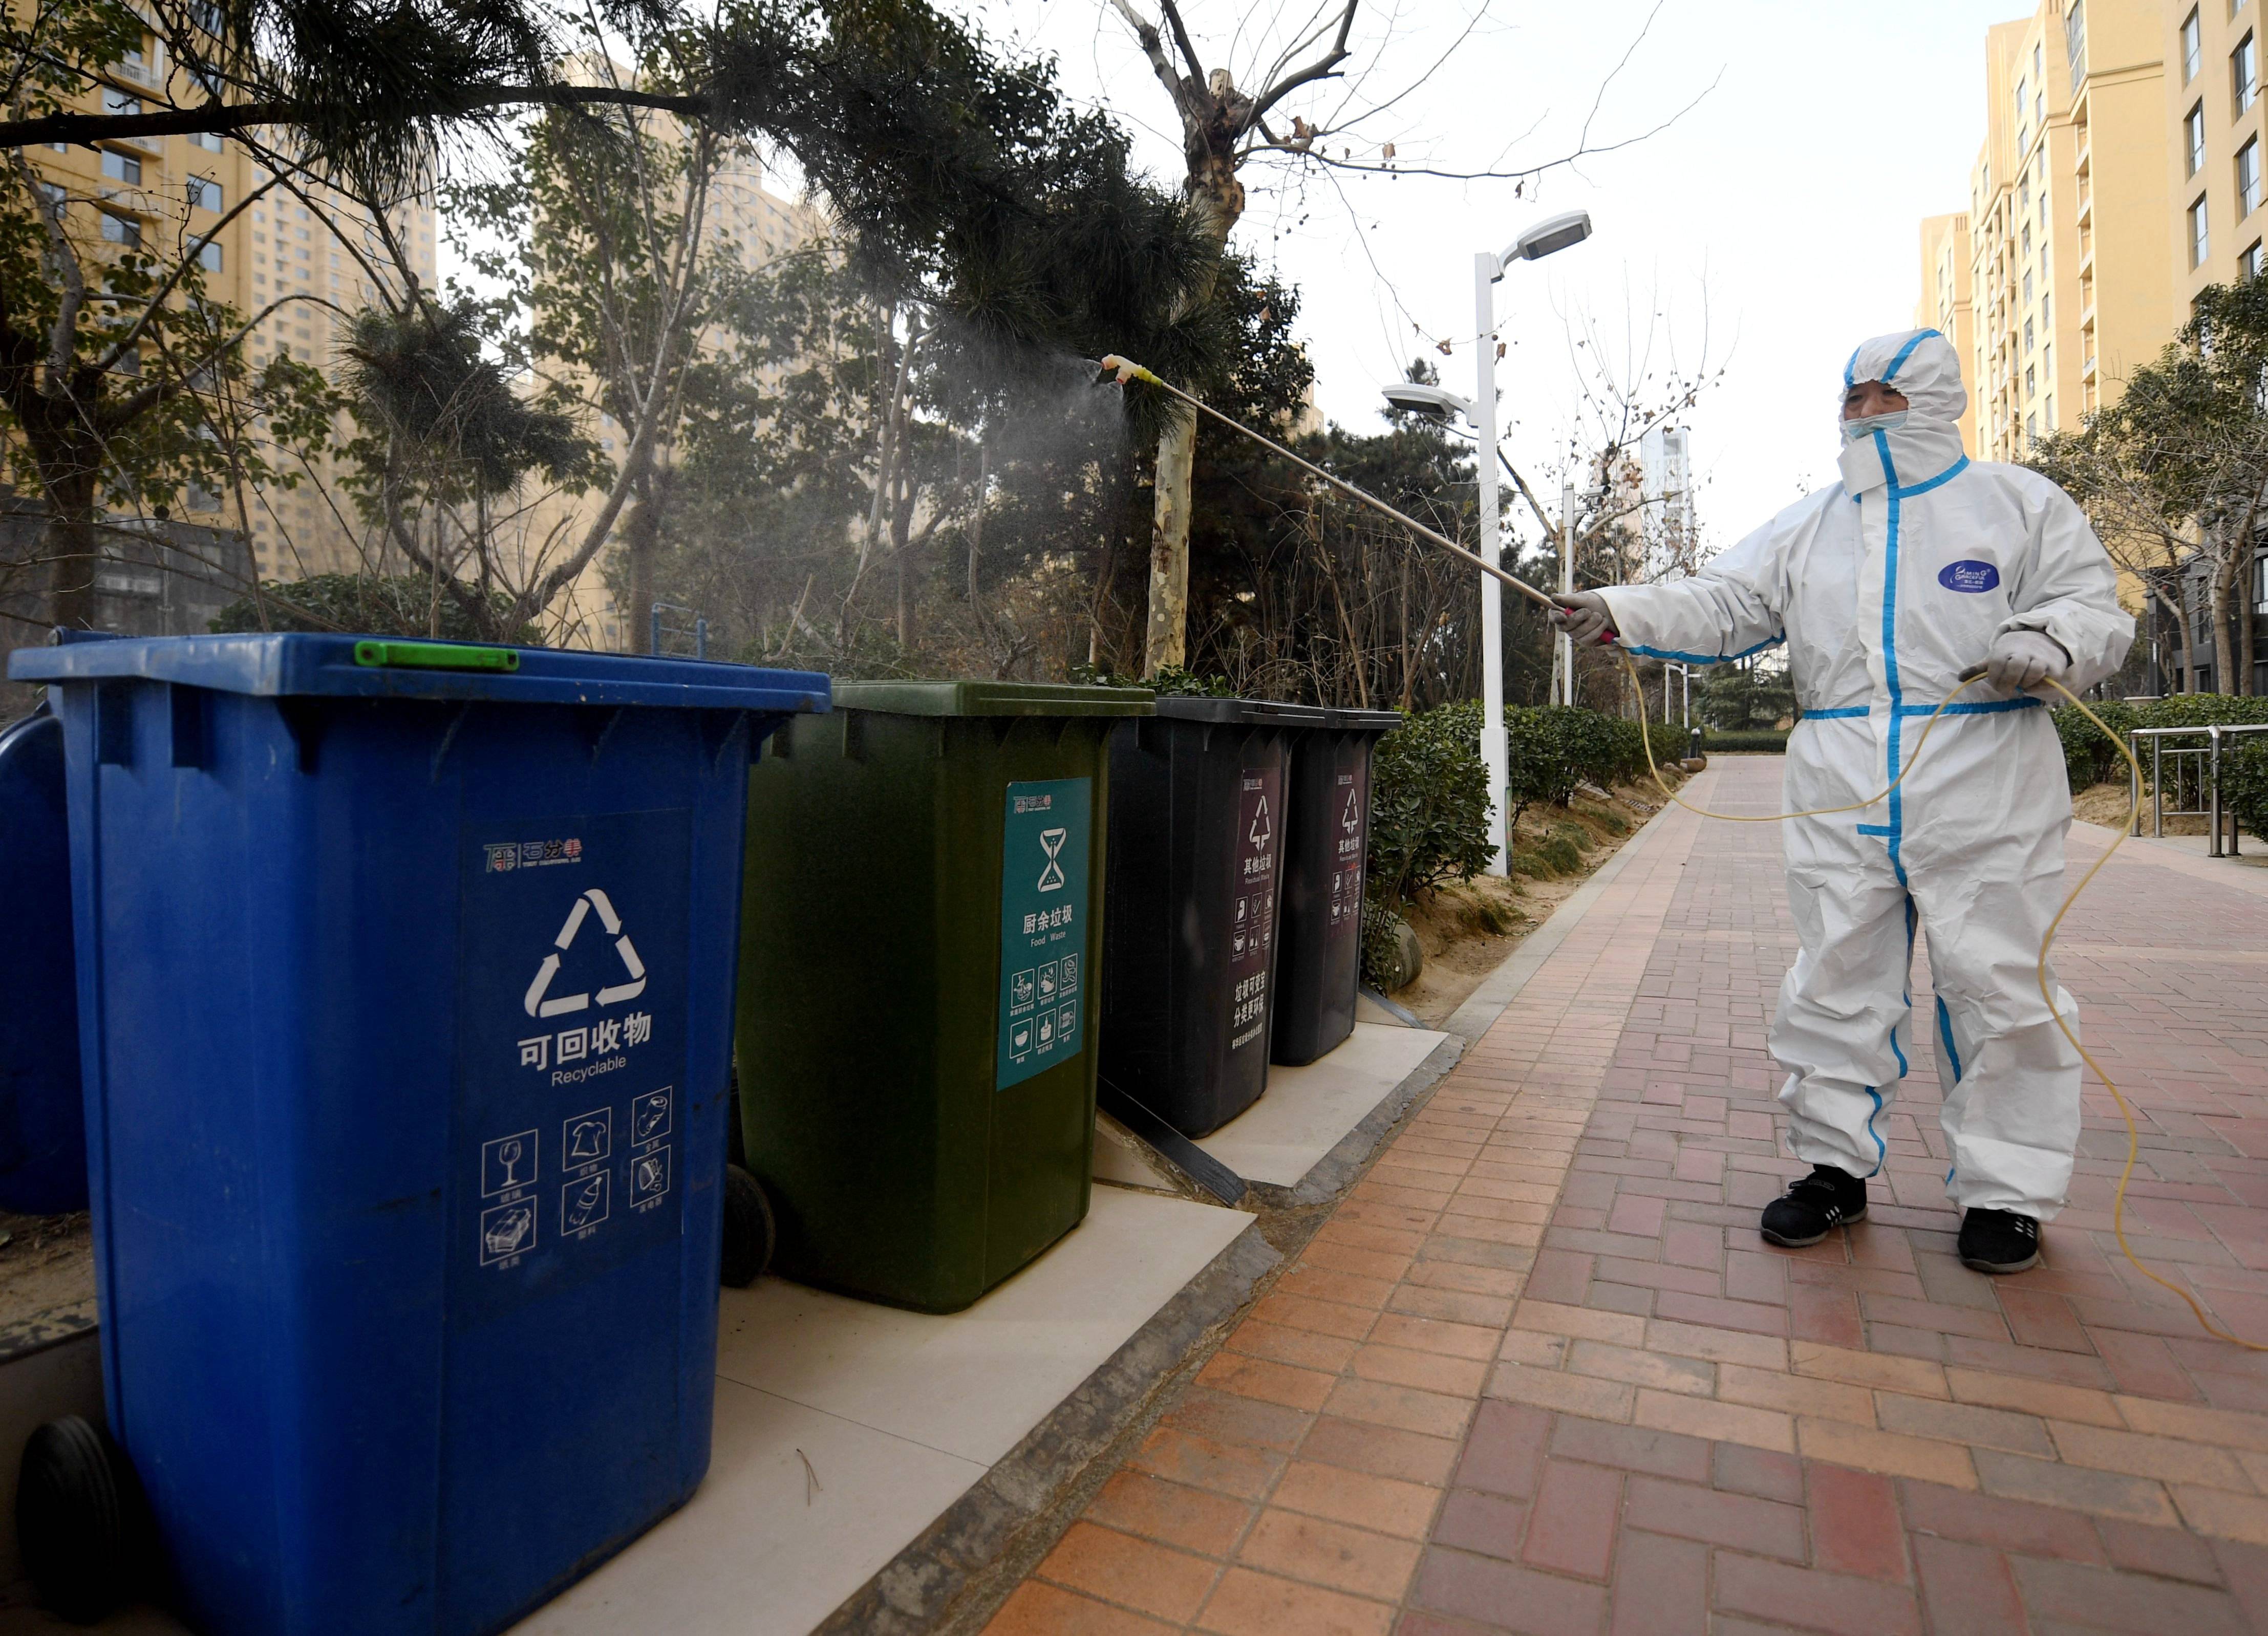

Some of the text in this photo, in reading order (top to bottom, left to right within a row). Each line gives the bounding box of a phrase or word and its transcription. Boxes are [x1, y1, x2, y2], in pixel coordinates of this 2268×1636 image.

[1244, 854, 1271, 875] 其他垃圾
[1023, 905, 1072, 934] 厨余垃圾
[1031, 932, 1066, 947] Food Waste
[1234, 994, 1264, 1028] 分类更环保
[517, 1011, 651, 1071] 可回收物
[551, 1056, 626, 1086] Recyclable
